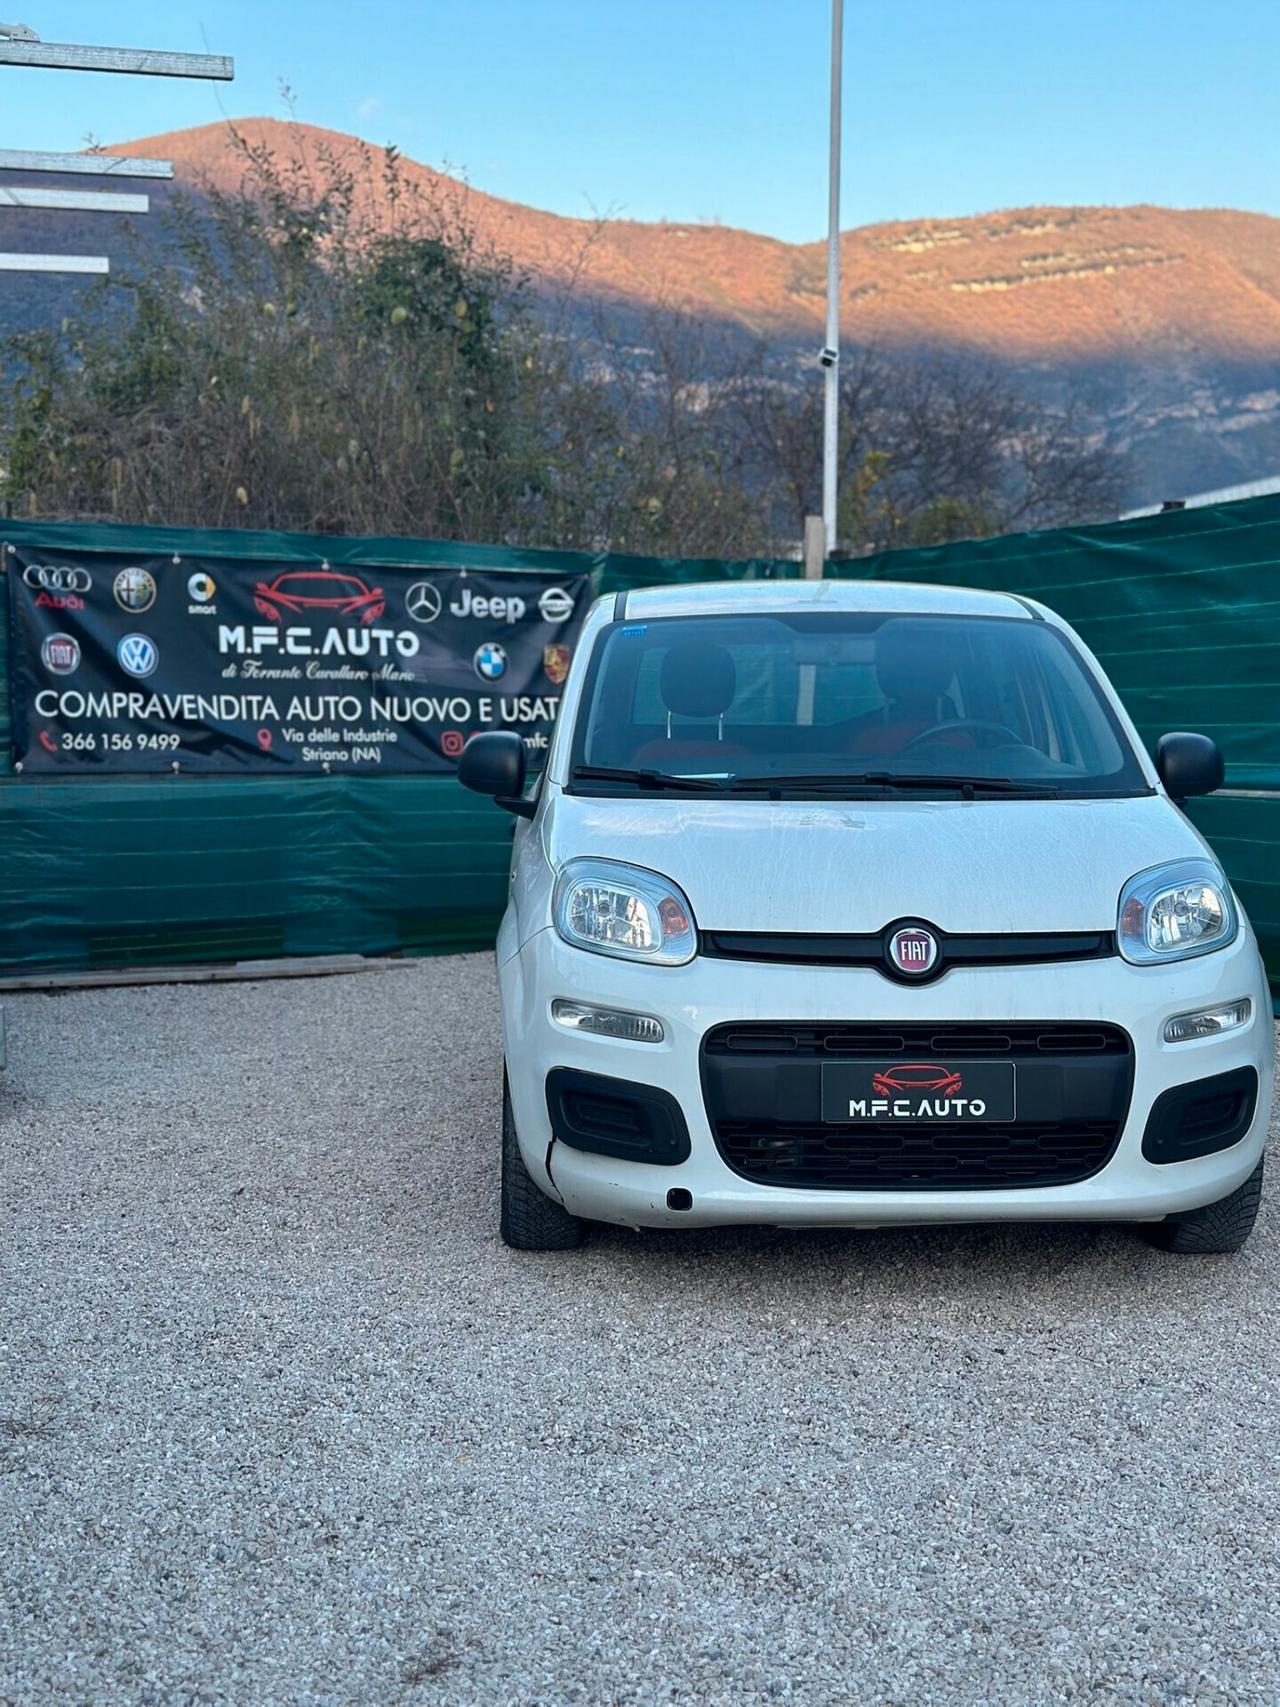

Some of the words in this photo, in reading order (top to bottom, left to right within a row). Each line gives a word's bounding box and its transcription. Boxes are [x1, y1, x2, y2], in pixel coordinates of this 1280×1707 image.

[34, 592, 84, 610] Audi
[188, 605, 216, 615] smart
[450, 589, 525, 624] Jeep
[218, 625, 420, 657] M.F.C.AUTO
[221, 663, 237, 679] di
[34, 690, 280, 722] COMPRAVENDITA
[285, 695, 362, 722] AUTO
[370, 696, 471, 722] NUOVO
[479, 698, 493, 722] E
[501, 697, 559, 723] USAT
[61, 733, 96, 751] 366
[102, 734, 132, 751] 156
[137, 734, 181, 752] 9499
[281, 728, 304, 743] Via
[307, 728, 340, 744] delle
[343, 728, 398, 744] Industrie
[302, 747, 349, 762] Striano
[351, 747, 382, 764] (NA)
[900, 941, 928, 961] FIAT
[848, 1099, 987, 1117] M.F.C.AUTO
